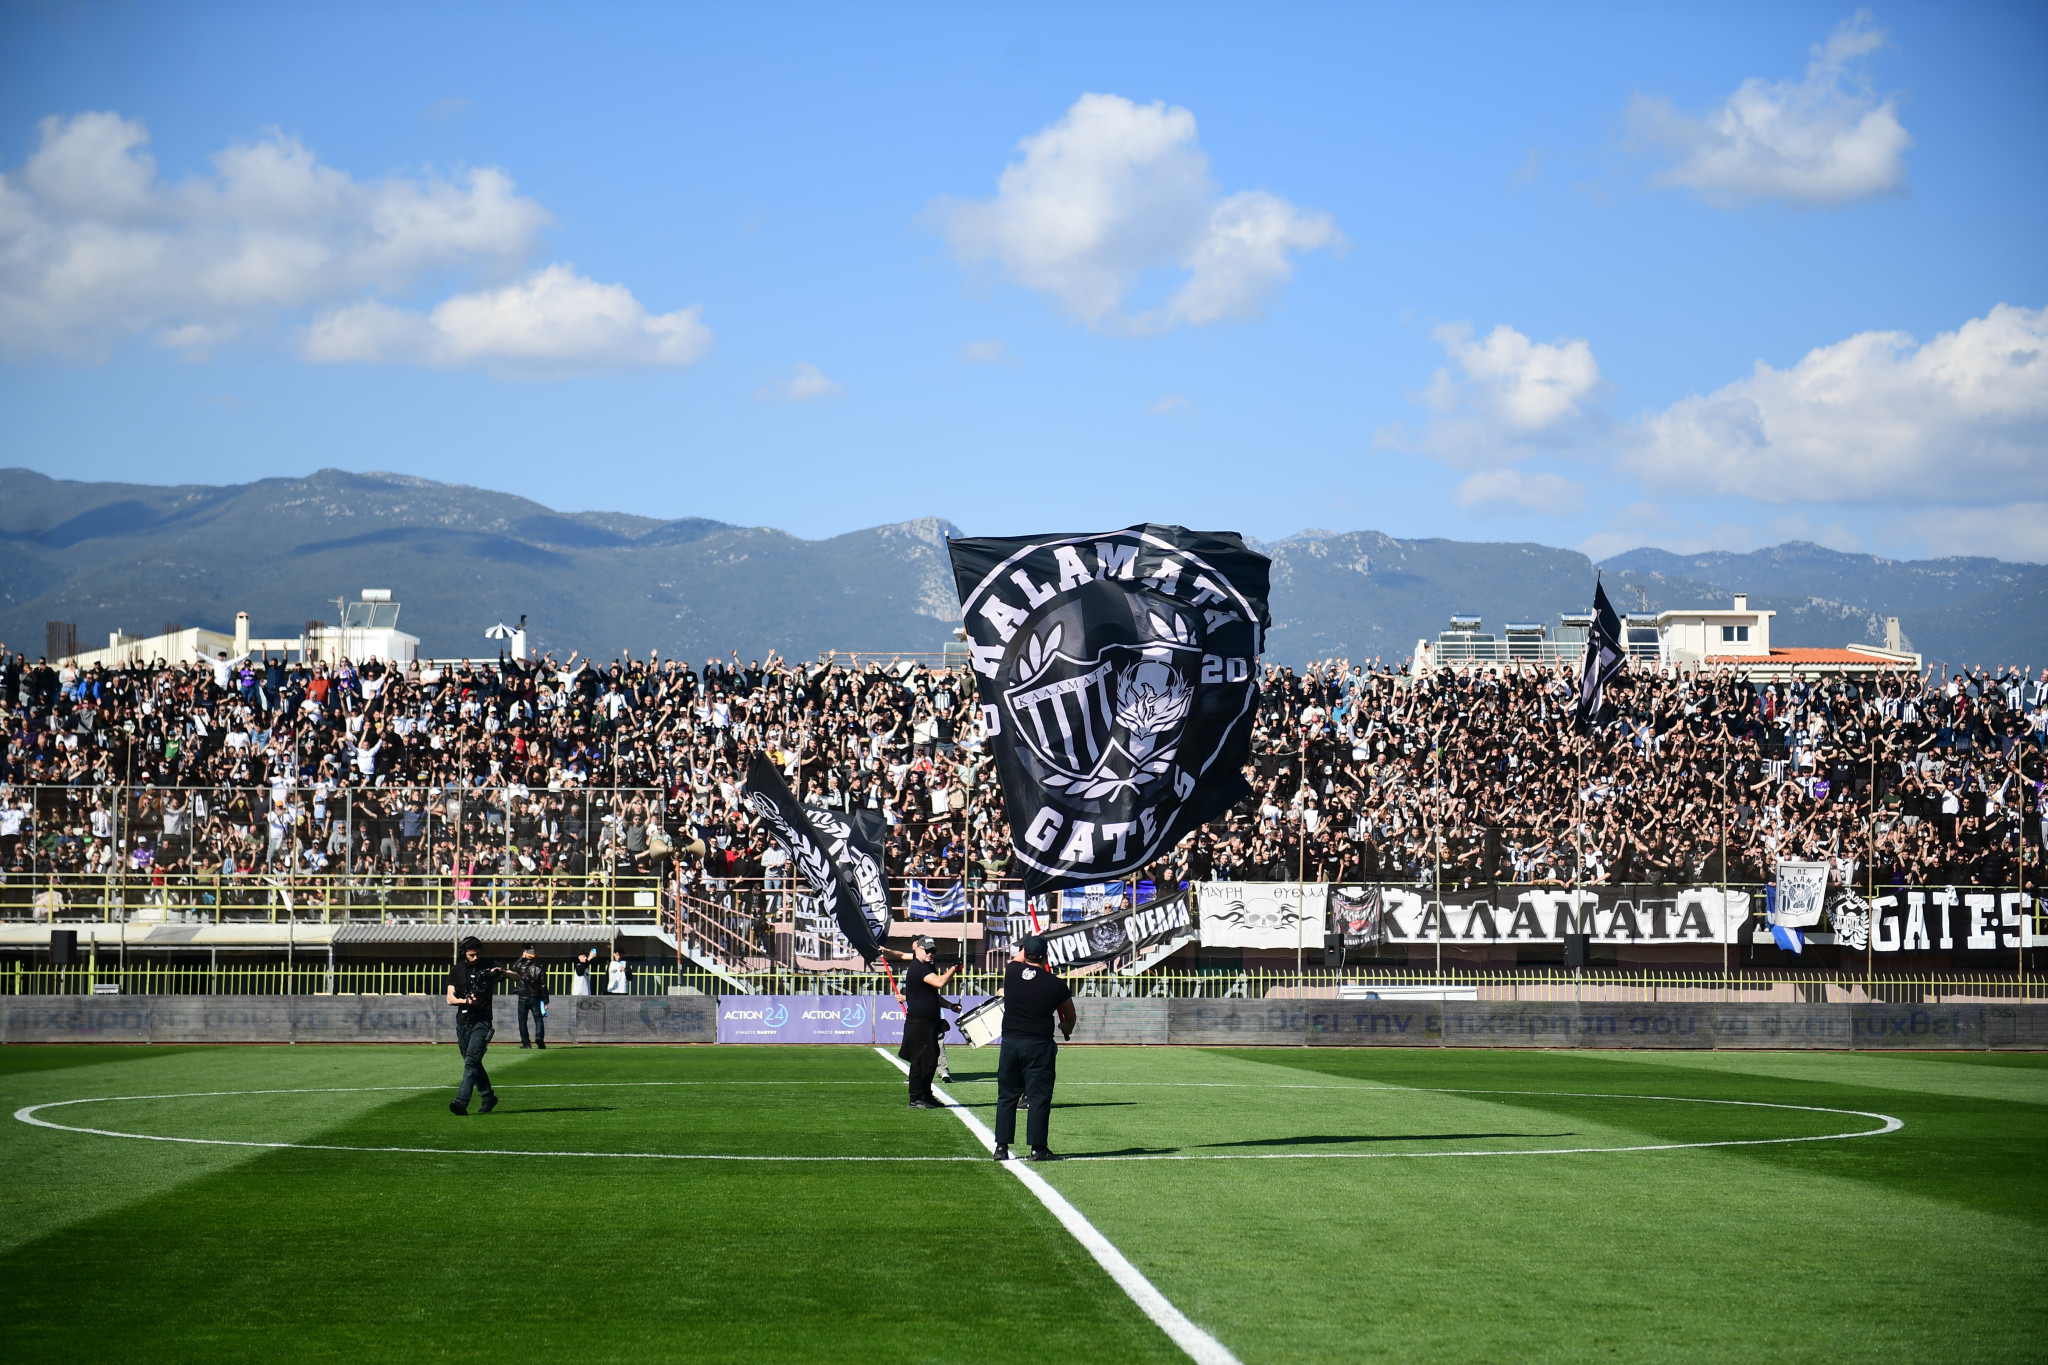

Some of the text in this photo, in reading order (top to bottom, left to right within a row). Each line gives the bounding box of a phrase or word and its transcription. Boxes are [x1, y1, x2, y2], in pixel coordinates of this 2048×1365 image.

[1017, 665, 1110, 706] ΚΑΛΑΜΑΤΑ
[1200, 886, 1243, 899] ΜΑΥΡΗ
[1047, 899, 1191, 968] ΑΥΡΗ ΘΥΕΛΛΑ
[7, 1003, 190, 1035] πιχείρηση
[724, 1007, 785, 1021] ACTION 24
[802, 1007, 862, 1021] ACTION 24
[880, 1011, 907, 1020] ACTI
[1353, 1013, 1413, 1034] την
[1629, 1015, 1698, 1036] σου
